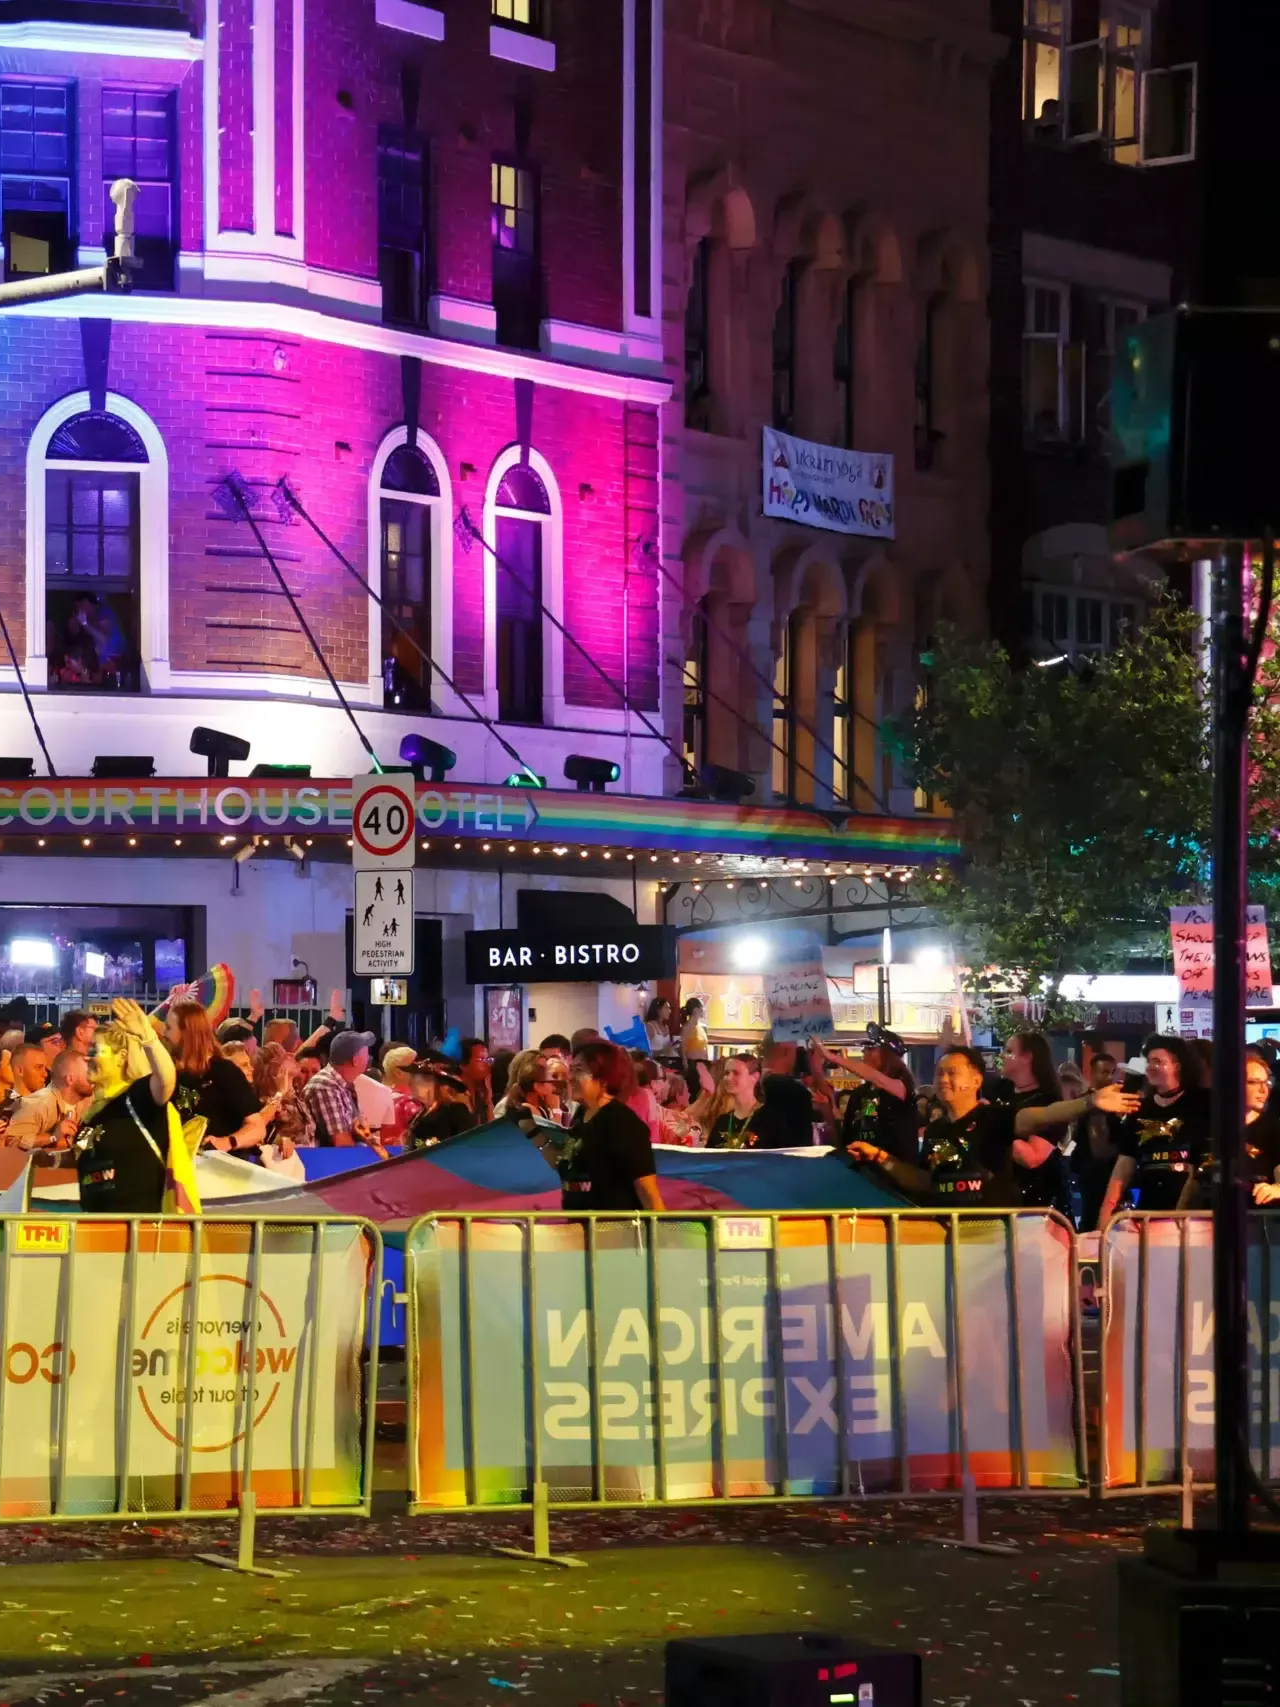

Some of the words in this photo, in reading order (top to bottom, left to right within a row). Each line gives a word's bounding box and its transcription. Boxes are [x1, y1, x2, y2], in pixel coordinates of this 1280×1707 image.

[363, 805, 405, 835] 40
[418, 790, 513, 832] OTEL
[362, 950, 404, 958] PEDESTRIAN
[489, 947, 532, 967] BAR
[555, 943, 640, 964] BISTRO
[492, 1007, 517, 1029] $15
[23, 1225, 61, 1241] TFH
